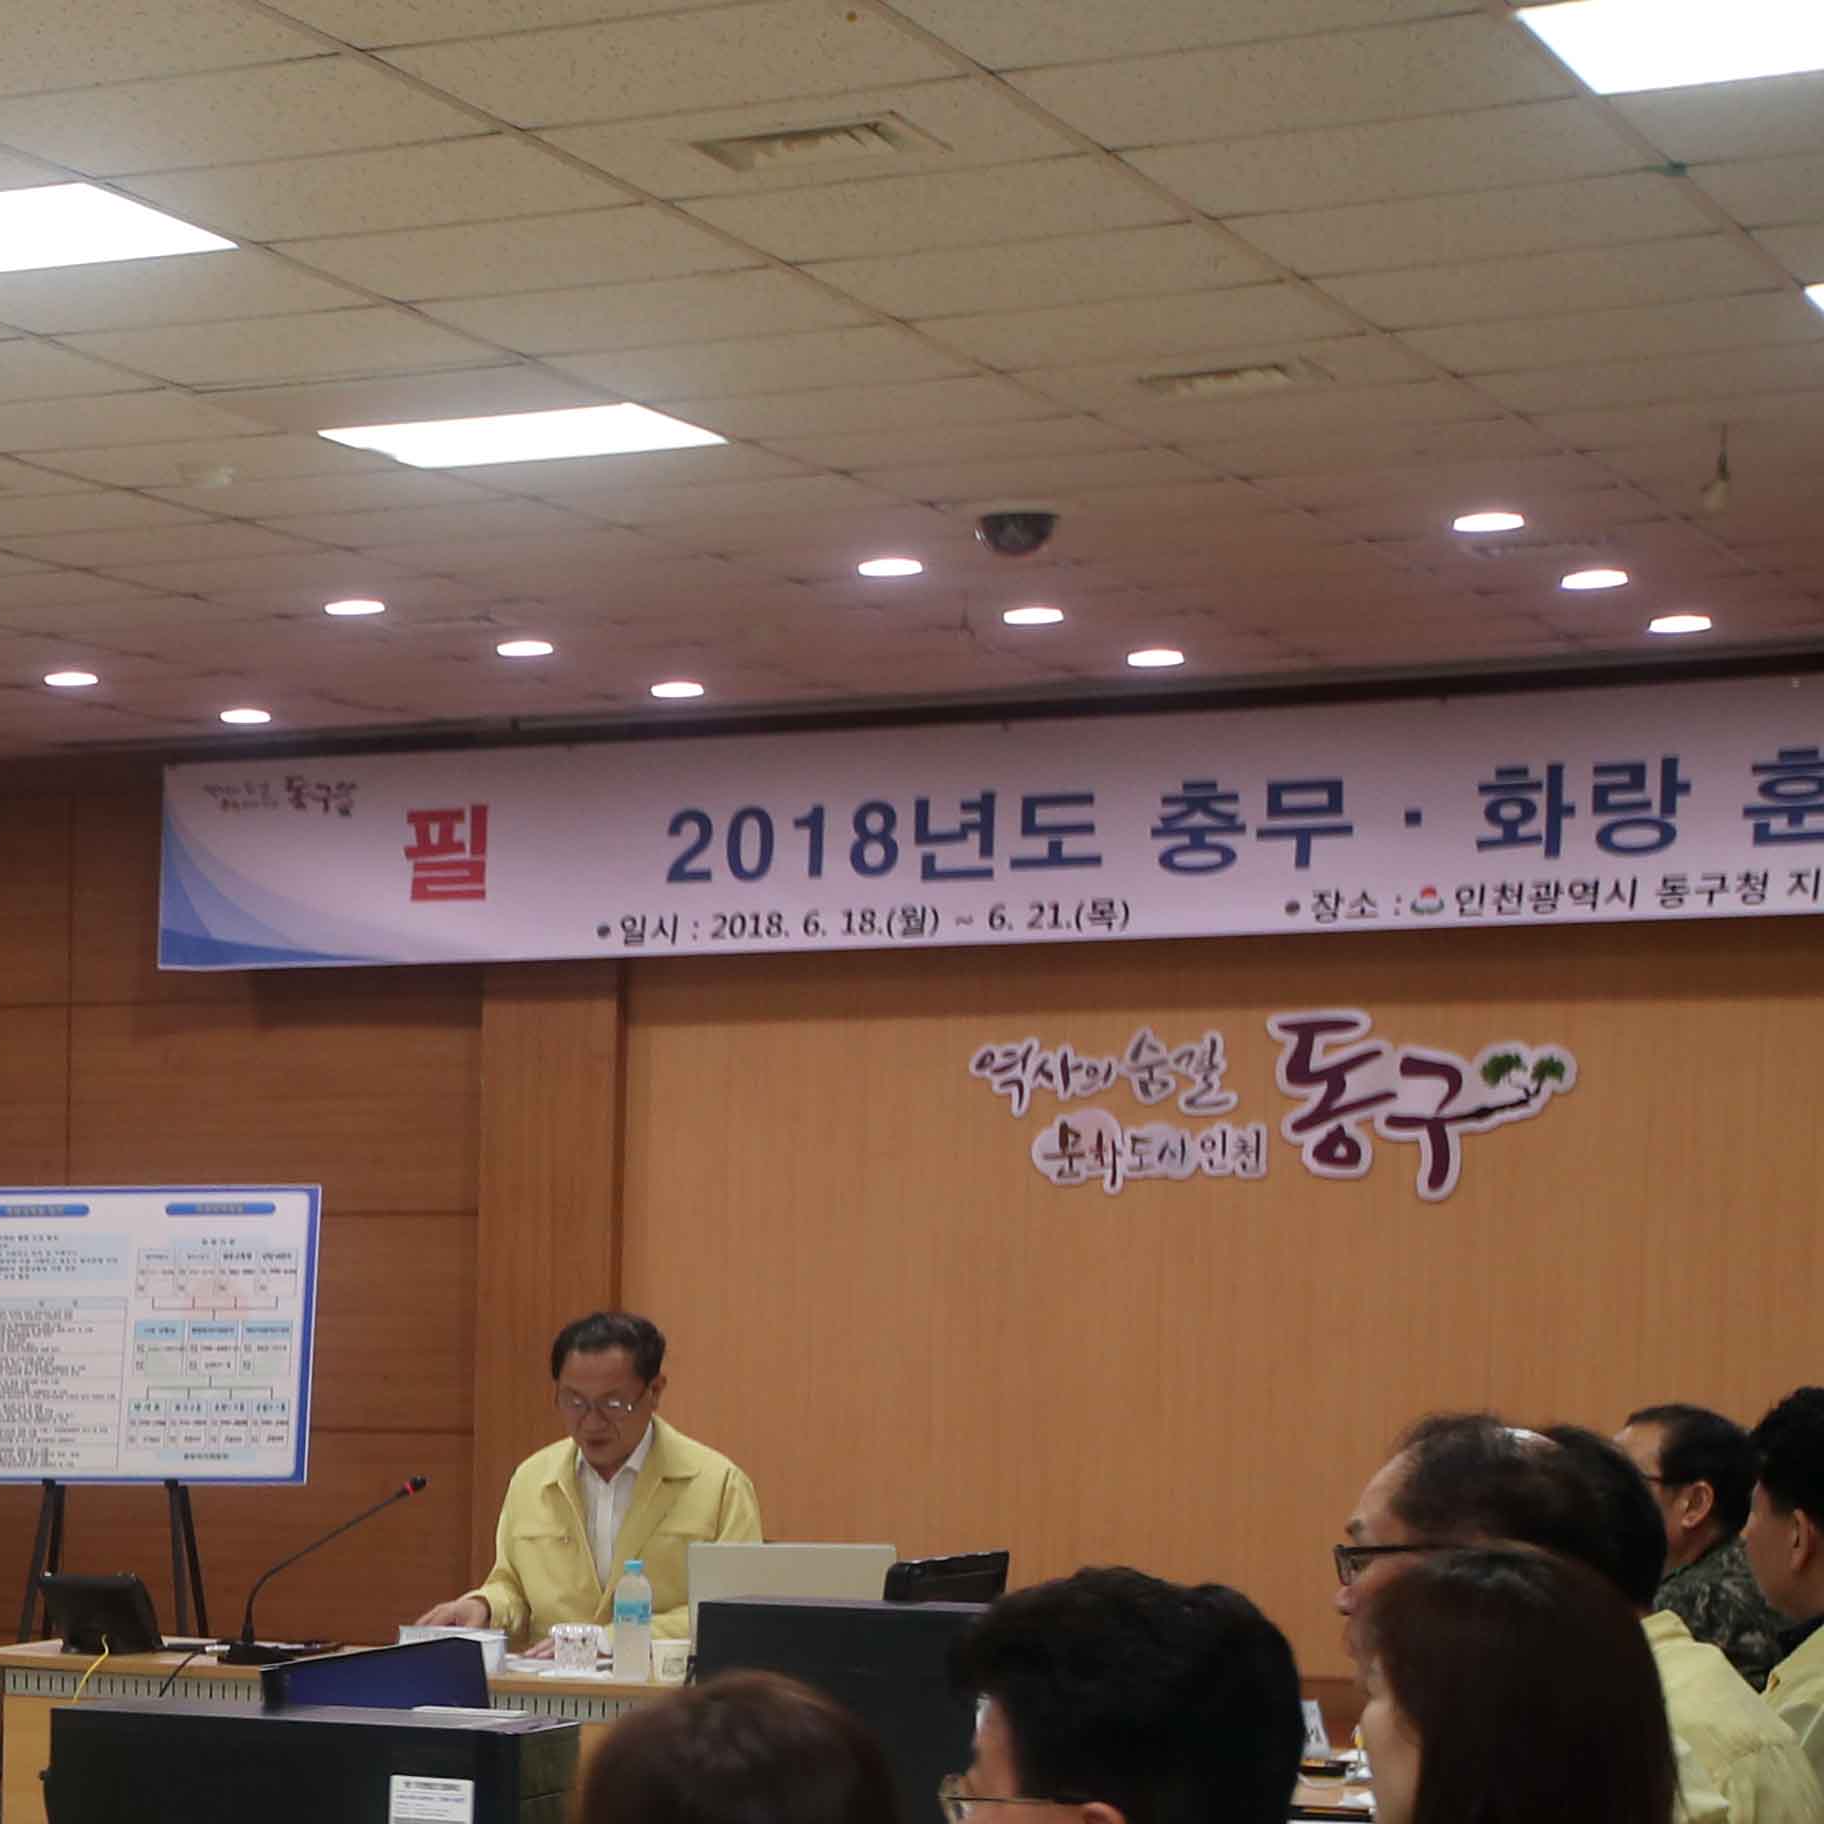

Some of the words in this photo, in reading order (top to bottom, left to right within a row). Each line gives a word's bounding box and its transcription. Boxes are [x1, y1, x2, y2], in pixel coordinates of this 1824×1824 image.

[404, 804, 489, 901] 필
[667, 789, 1103, 883] 2018년도
[1151, 779, 1353, 876] 충무
[1476, 755, 1691, 858] 화랑
[620, 912, 679, 945] 일시
[711, 910, 790, 940] 2018.
[803, 908, 828, 938] 6.
[988, 903, 1014, 931] 6.
[1311, 889, 1379, 924] 장소
[1455, 875, 1638, 917] 인천광역시
[1656, 867, 1768, 909] 동구청
[1787, 868, 1822, 903] 지
[1278, 1016, 1472, 1191] 동구
[1201, 1127, 1261, 1172] 인천
